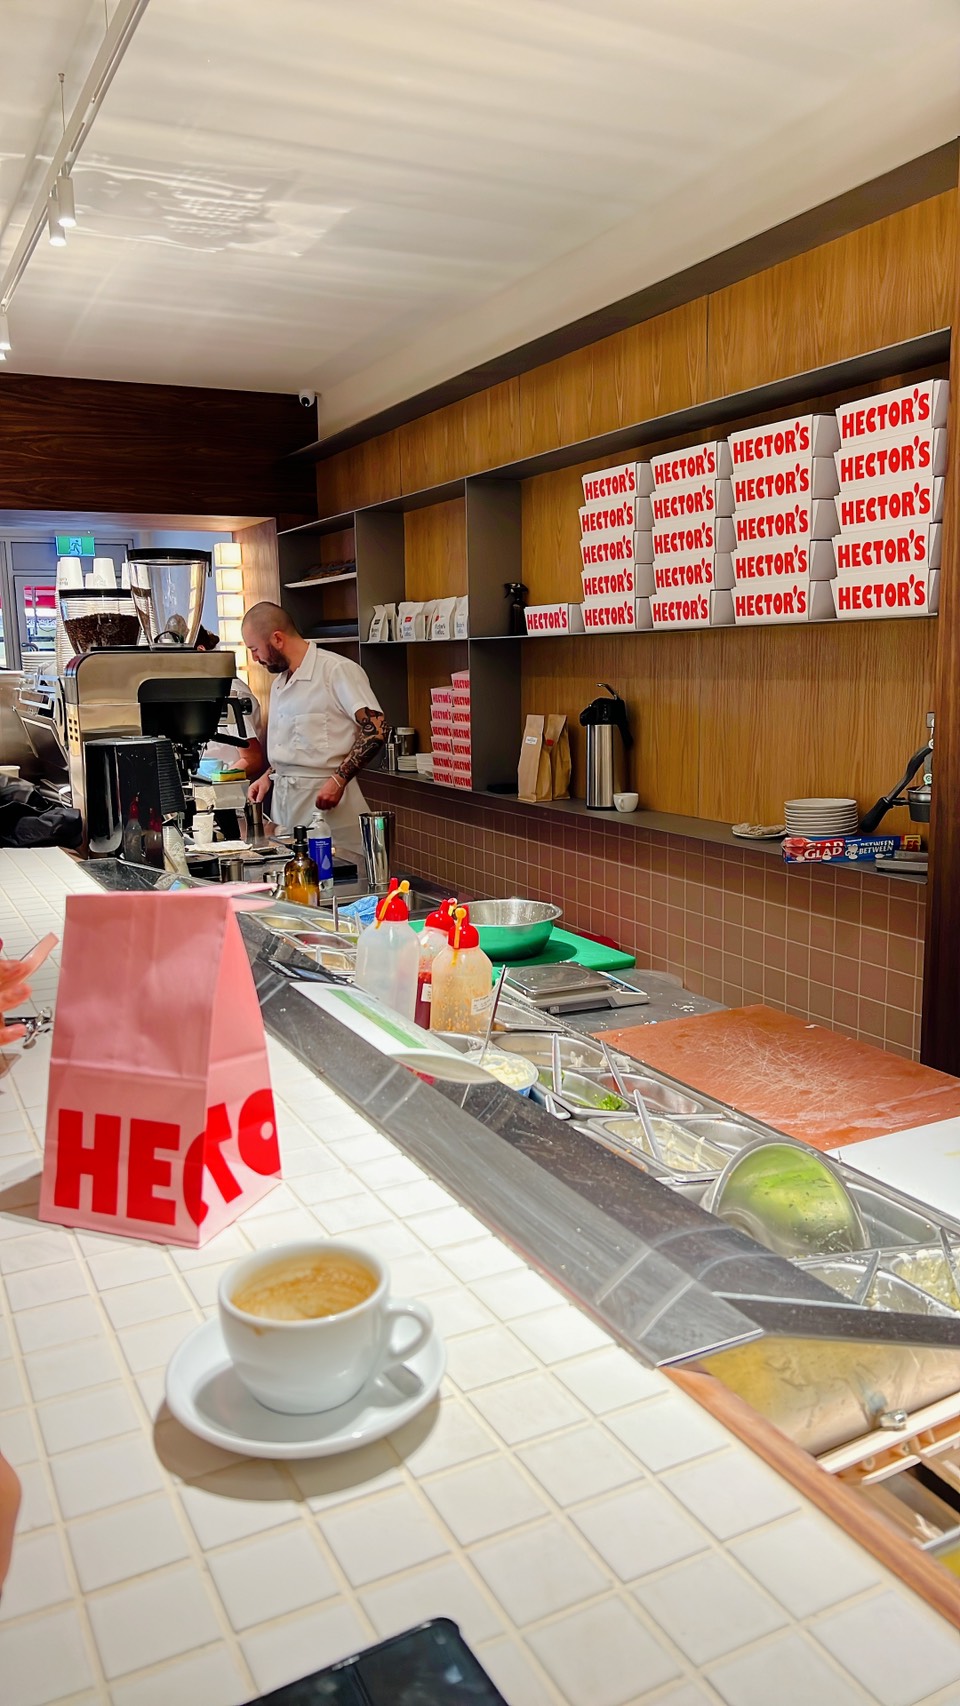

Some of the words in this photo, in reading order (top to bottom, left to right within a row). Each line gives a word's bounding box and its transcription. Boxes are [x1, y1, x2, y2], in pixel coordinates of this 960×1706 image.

[842, 388, 929, 438] HECTOR'S
[734, 422, 809, 464] HECTOR'S
[655, 448, 715, 484] HECTOR'S
[841, 436, 930, 482] HECTOR'S
[585, 468, 635, 499] HECTOR'S
[736, 464, 809, 502] HECTOR'S
[582, 502, 633, 531] HECTOR'S
[654, 485, 713, 519] HECTOR'S
[842, 483, 930, 525] HECTOR'S
[654, 522, 713, 554] HECTOR'S
[737, 505, 808, 541] HECTOR'S
[584, 537, 632, 563] HECTOR'S
[736, 546, 807, 578] HECTOR'S
[838, 529, 925, 568] HECTOR'S
[584, 569, 633, 594] HECTOR'S
[656, 558, 712, 588] HECTOR'S
[736, 586, 806, 616] HECTOR'S
[839, 574, 925, 610] HECTOR'S
[528, 610, 567, 629] HECTOR'S
[585, 602, 633, 626] HECTOR'S
[653, 595, 708, 621] HECTOR'S
[432, 692, 452, 703] HECTOR'S
[432, 709, 452, 720] HECTOR'S
[432, 726, 452, 736] HECTOR'S
[432, 741, 452, 752] HECTOR'S
[433, 757, 453, 767] HECTOR'S
[434, 772, 453, 784] HECTOR'S
[804, 847, 843, 860] GLAD
